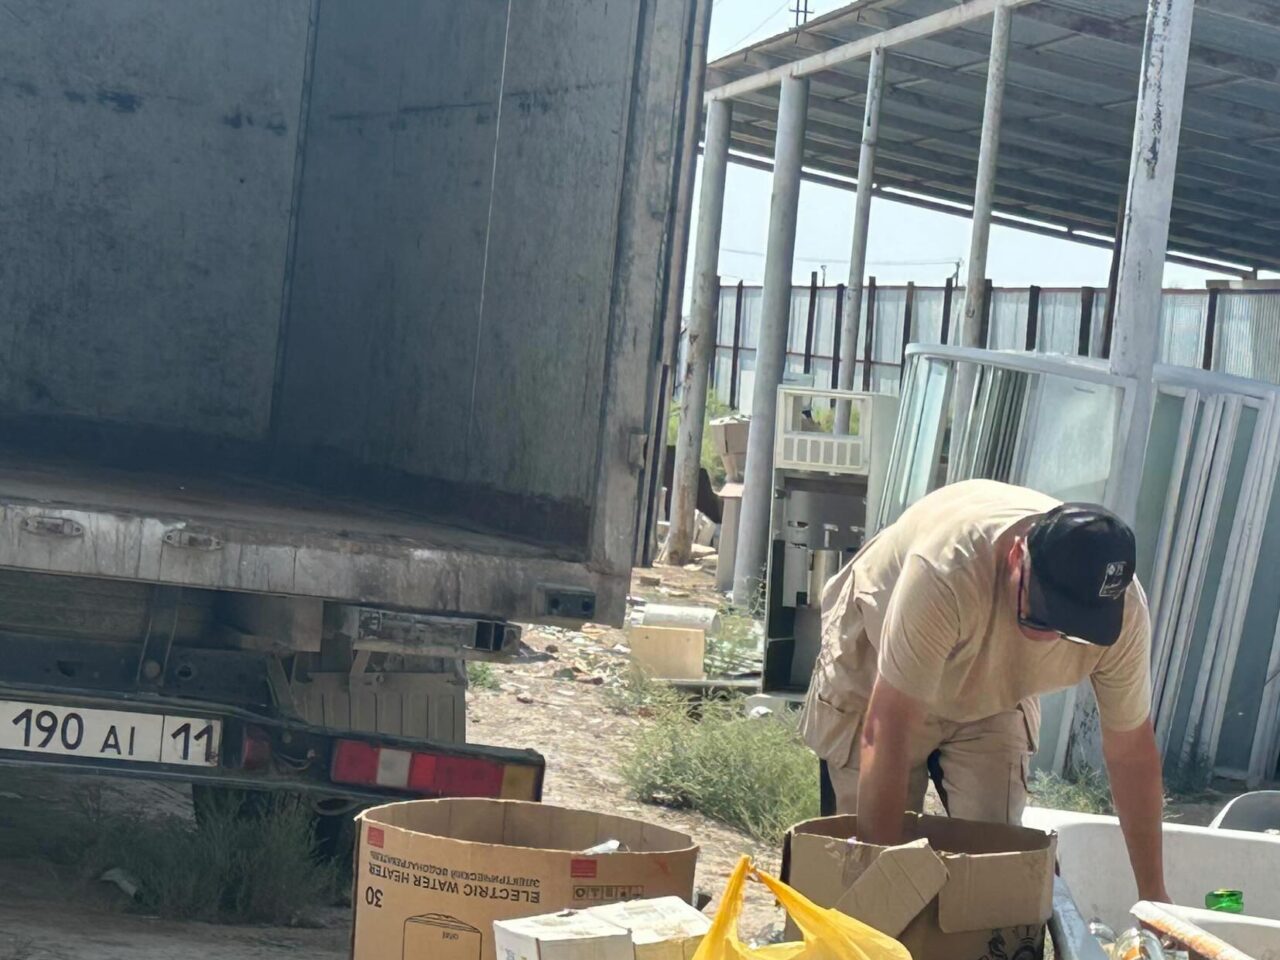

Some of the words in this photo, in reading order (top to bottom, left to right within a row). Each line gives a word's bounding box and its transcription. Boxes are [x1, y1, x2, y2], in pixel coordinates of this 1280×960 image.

[11, 708, 85, 751] 190
[170, 722, 215, 763] 11
[368, 861, 410, 884] HEATER
[414, 875, 460, 894] WATER
[463, 883, 541, 904] ELECTRIC
[365, 886, 384, 908] 30
